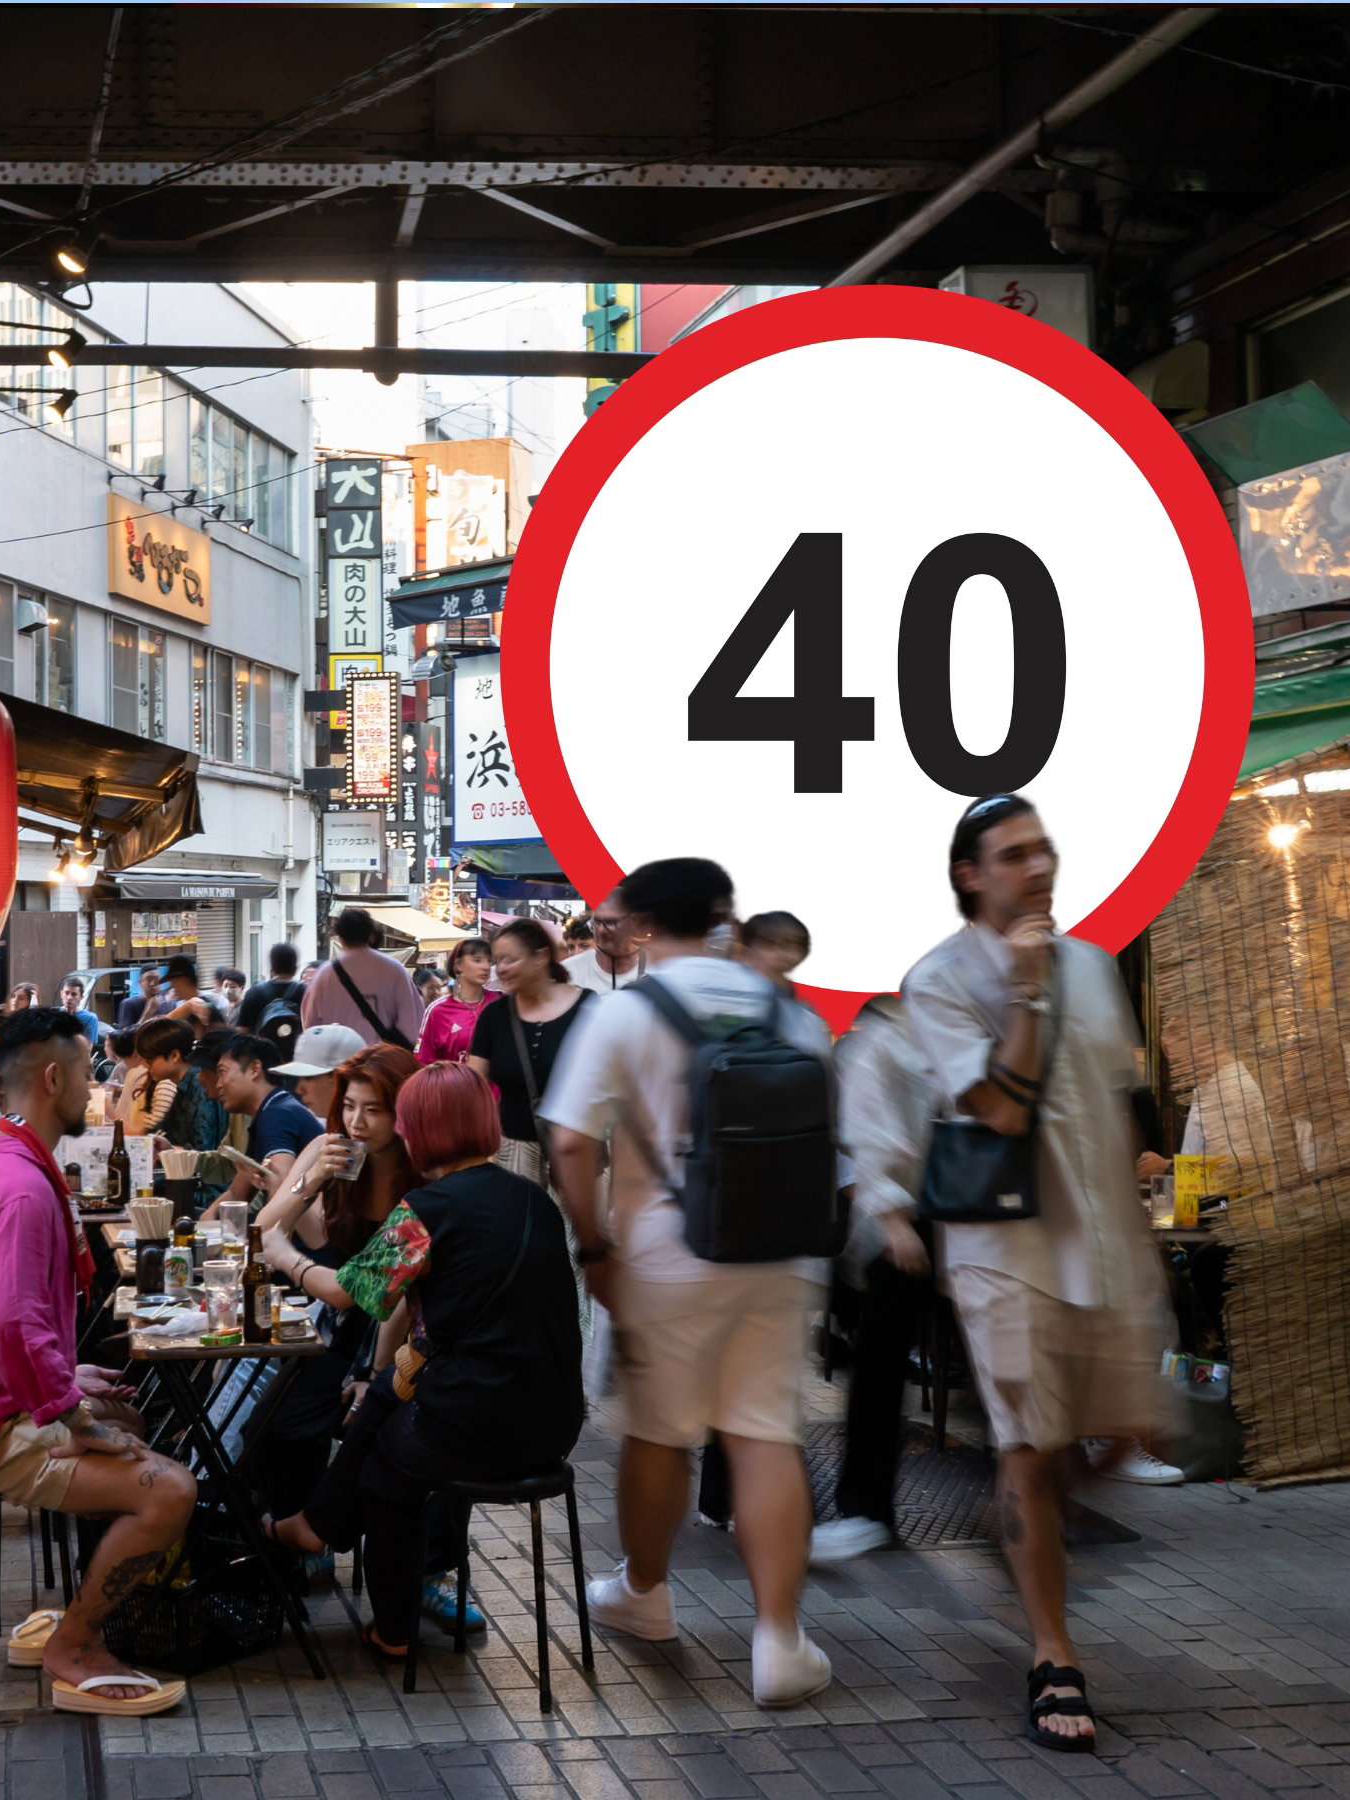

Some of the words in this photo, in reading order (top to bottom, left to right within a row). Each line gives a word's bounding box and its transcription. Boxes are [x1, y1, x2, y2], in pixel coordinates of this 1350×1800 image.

[331, 464, 378, 553] 大山
[343, 562, 367, 648] 肉の大山
[466, 730, 519, 789] 浜
[326, 837, 378, 846] エリアクエスト
[181, 886, 189, 897] LA
